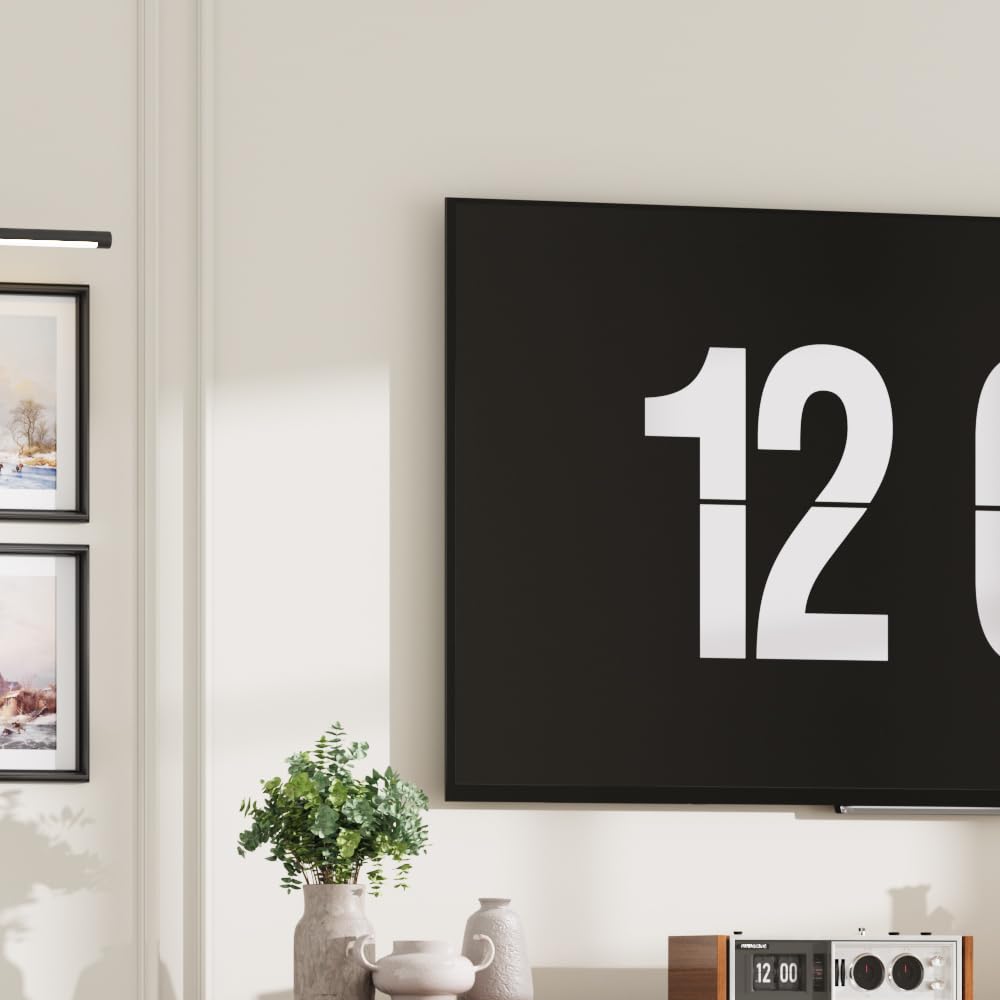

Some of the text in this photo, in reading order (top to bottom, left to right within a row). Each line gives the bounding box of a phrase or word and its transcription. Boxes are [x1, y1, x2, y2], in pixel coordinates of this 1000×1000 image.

[644, 343, 894, 662] 12
[755, 962, 798, 983] 12 00
